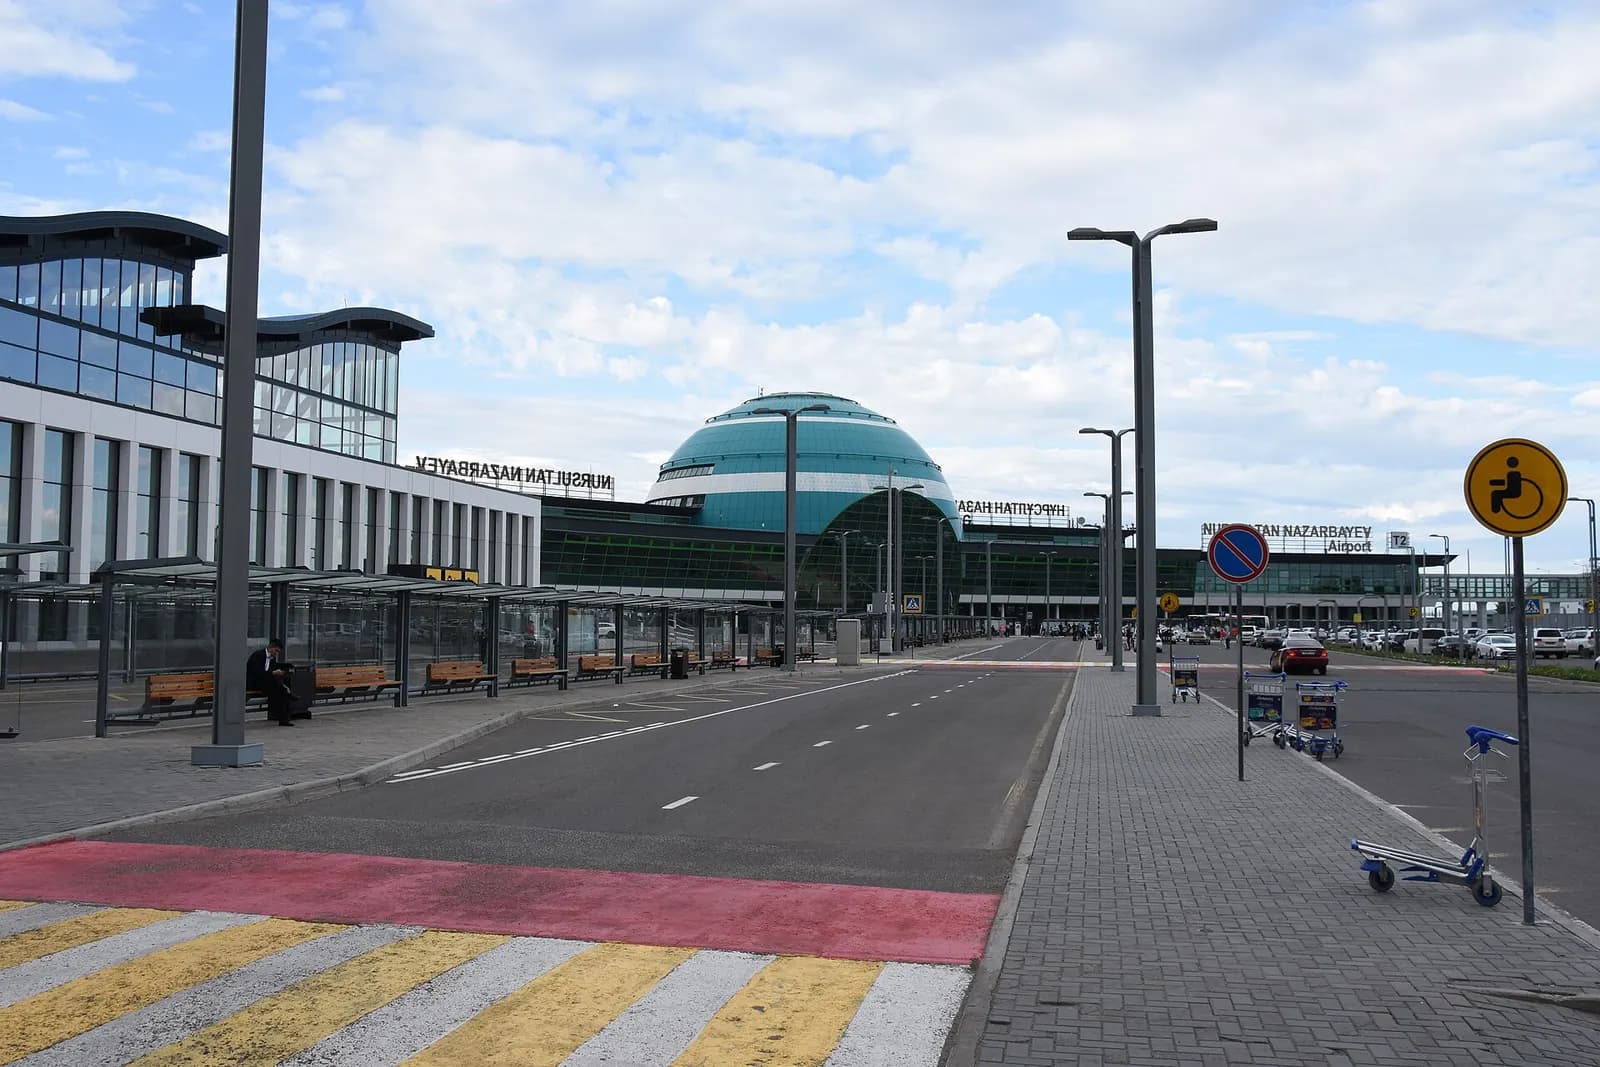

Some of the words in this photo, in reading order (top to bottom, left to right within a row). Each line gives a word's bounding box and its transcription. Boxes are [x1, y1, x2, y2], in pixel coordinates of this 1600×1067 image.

[1283, 524, 1372, 539] NAZARBAYEV
[1328, 540, 1372, 553] Airport
[1392, 535, 1407, 545] T2
